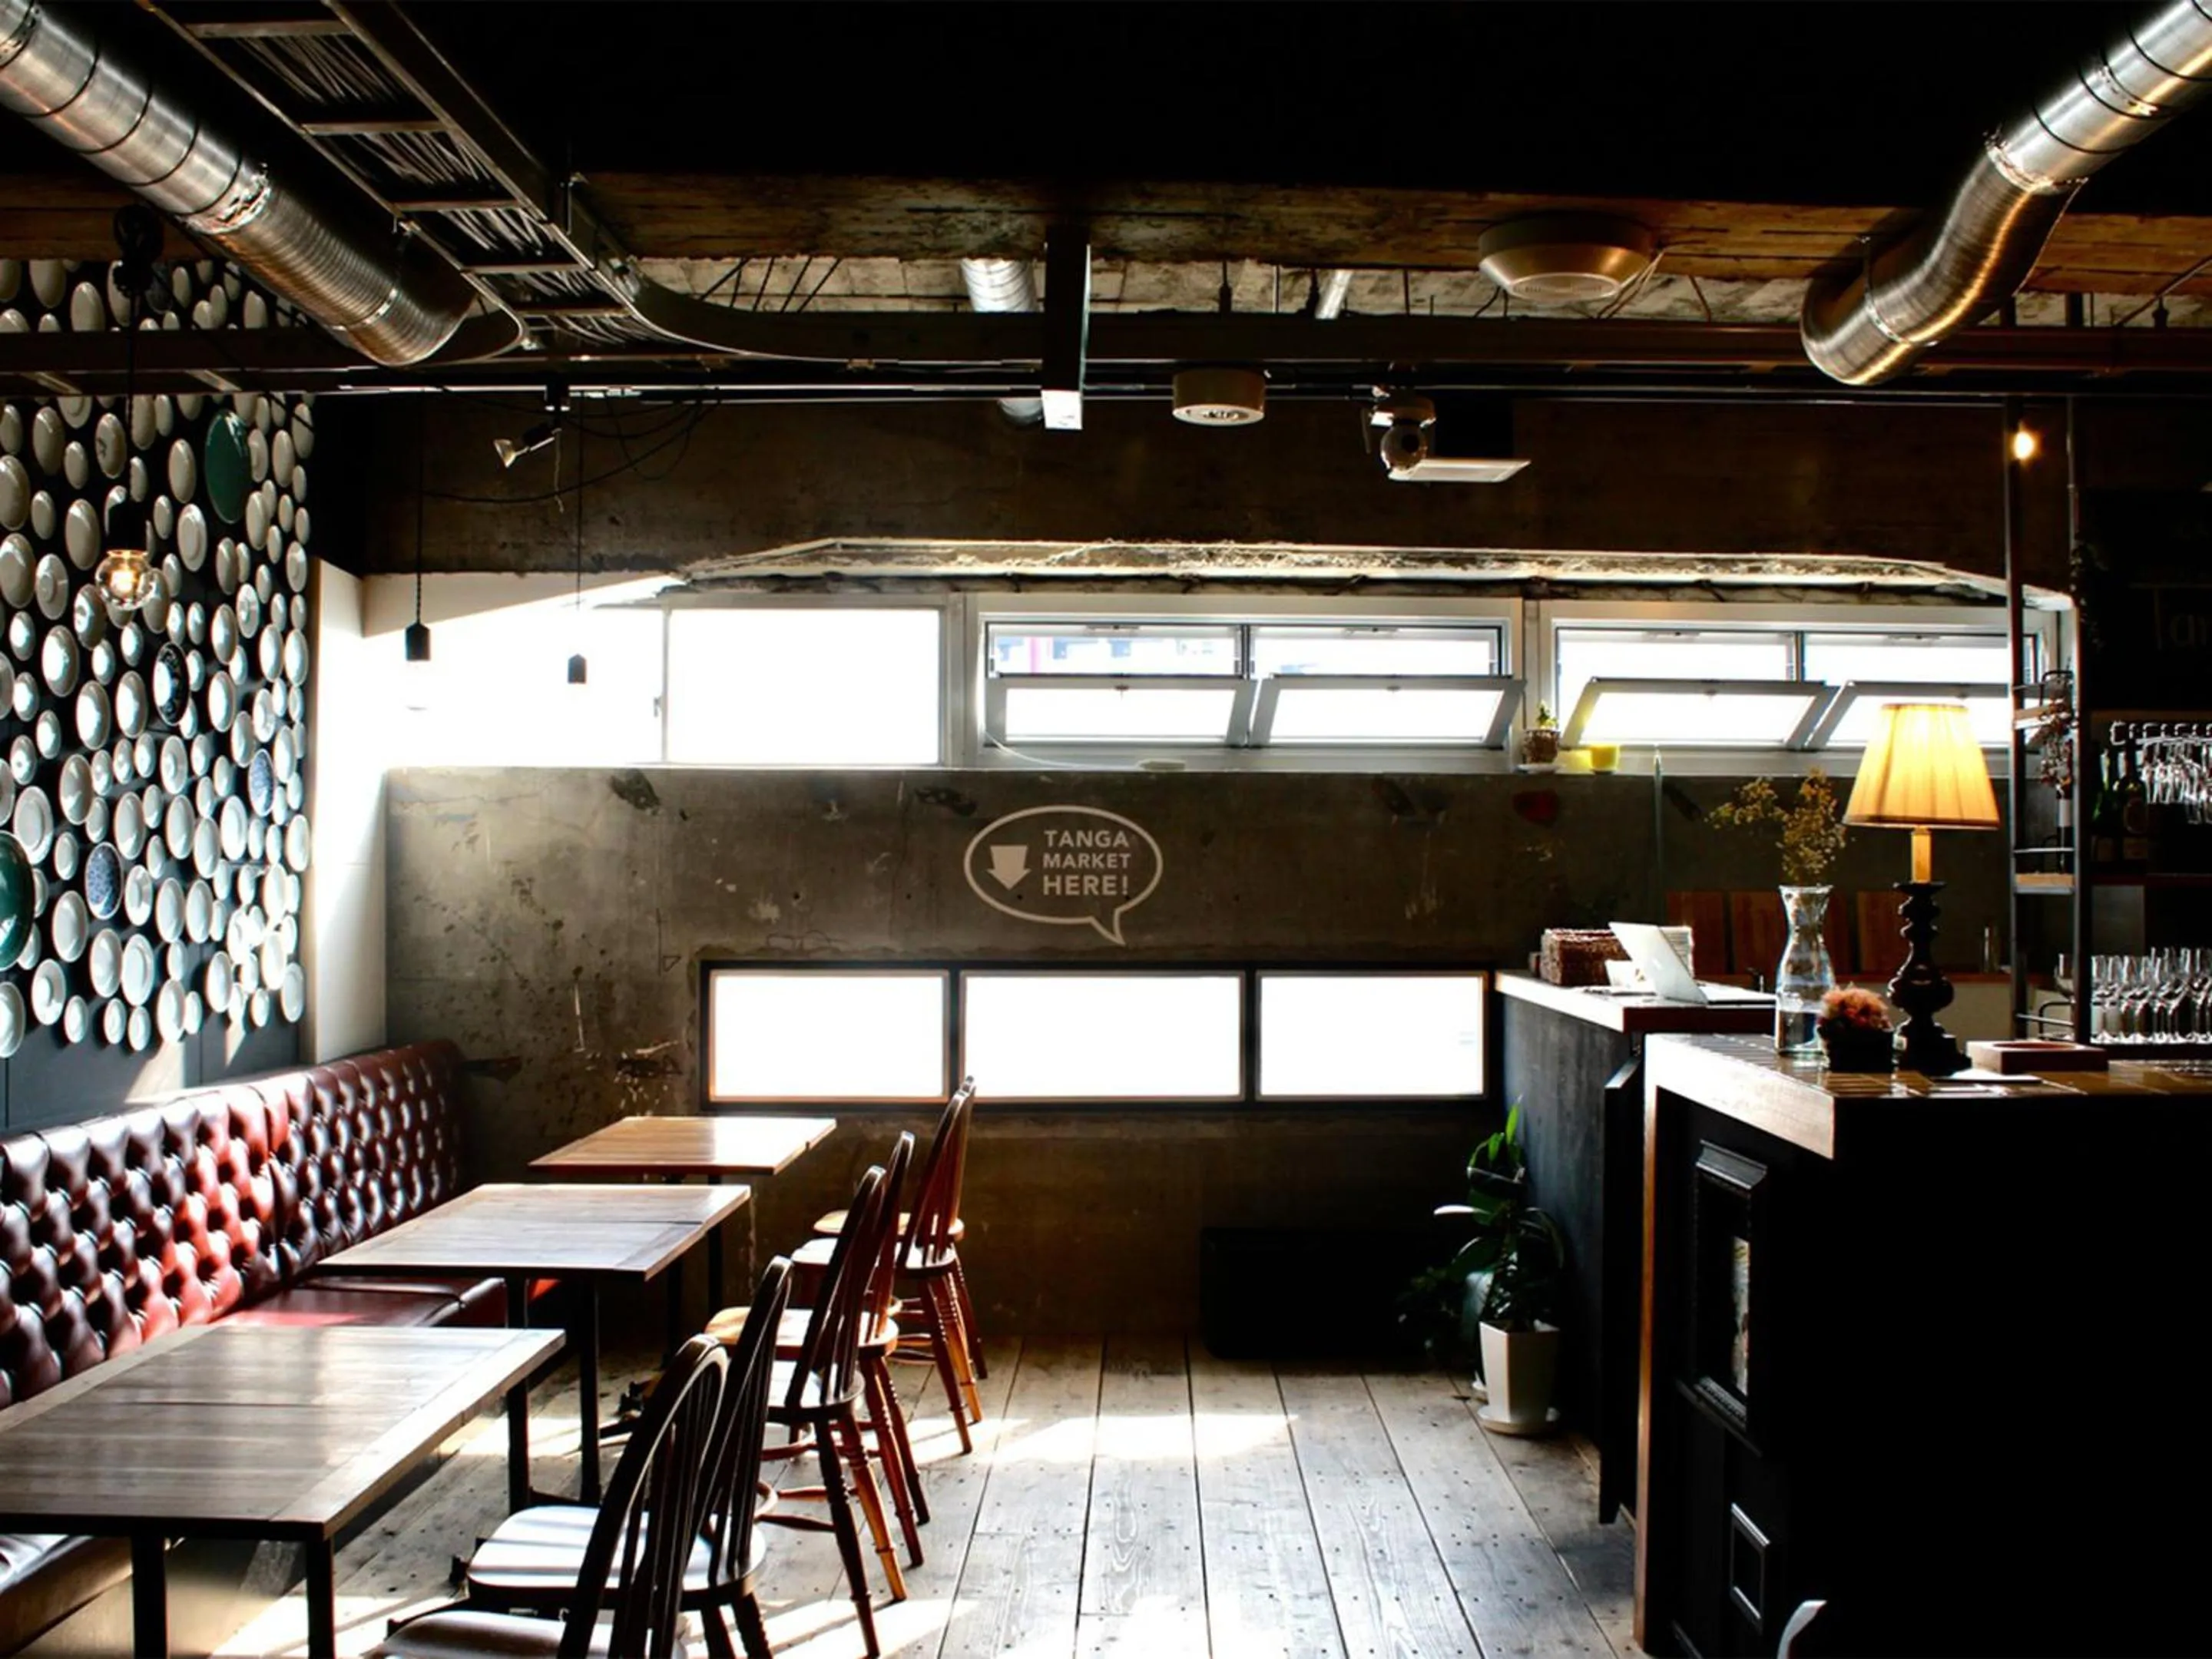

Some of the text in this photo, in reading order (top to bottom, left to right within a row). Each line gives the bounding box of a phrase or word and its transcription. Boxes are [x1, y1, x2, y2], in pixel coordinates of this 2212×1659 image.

[1044, 830, 1130, 848] TANGA
[1042, 853, 1131, 869] MARKET
[1043, 874, 1128, 896] HERE!
